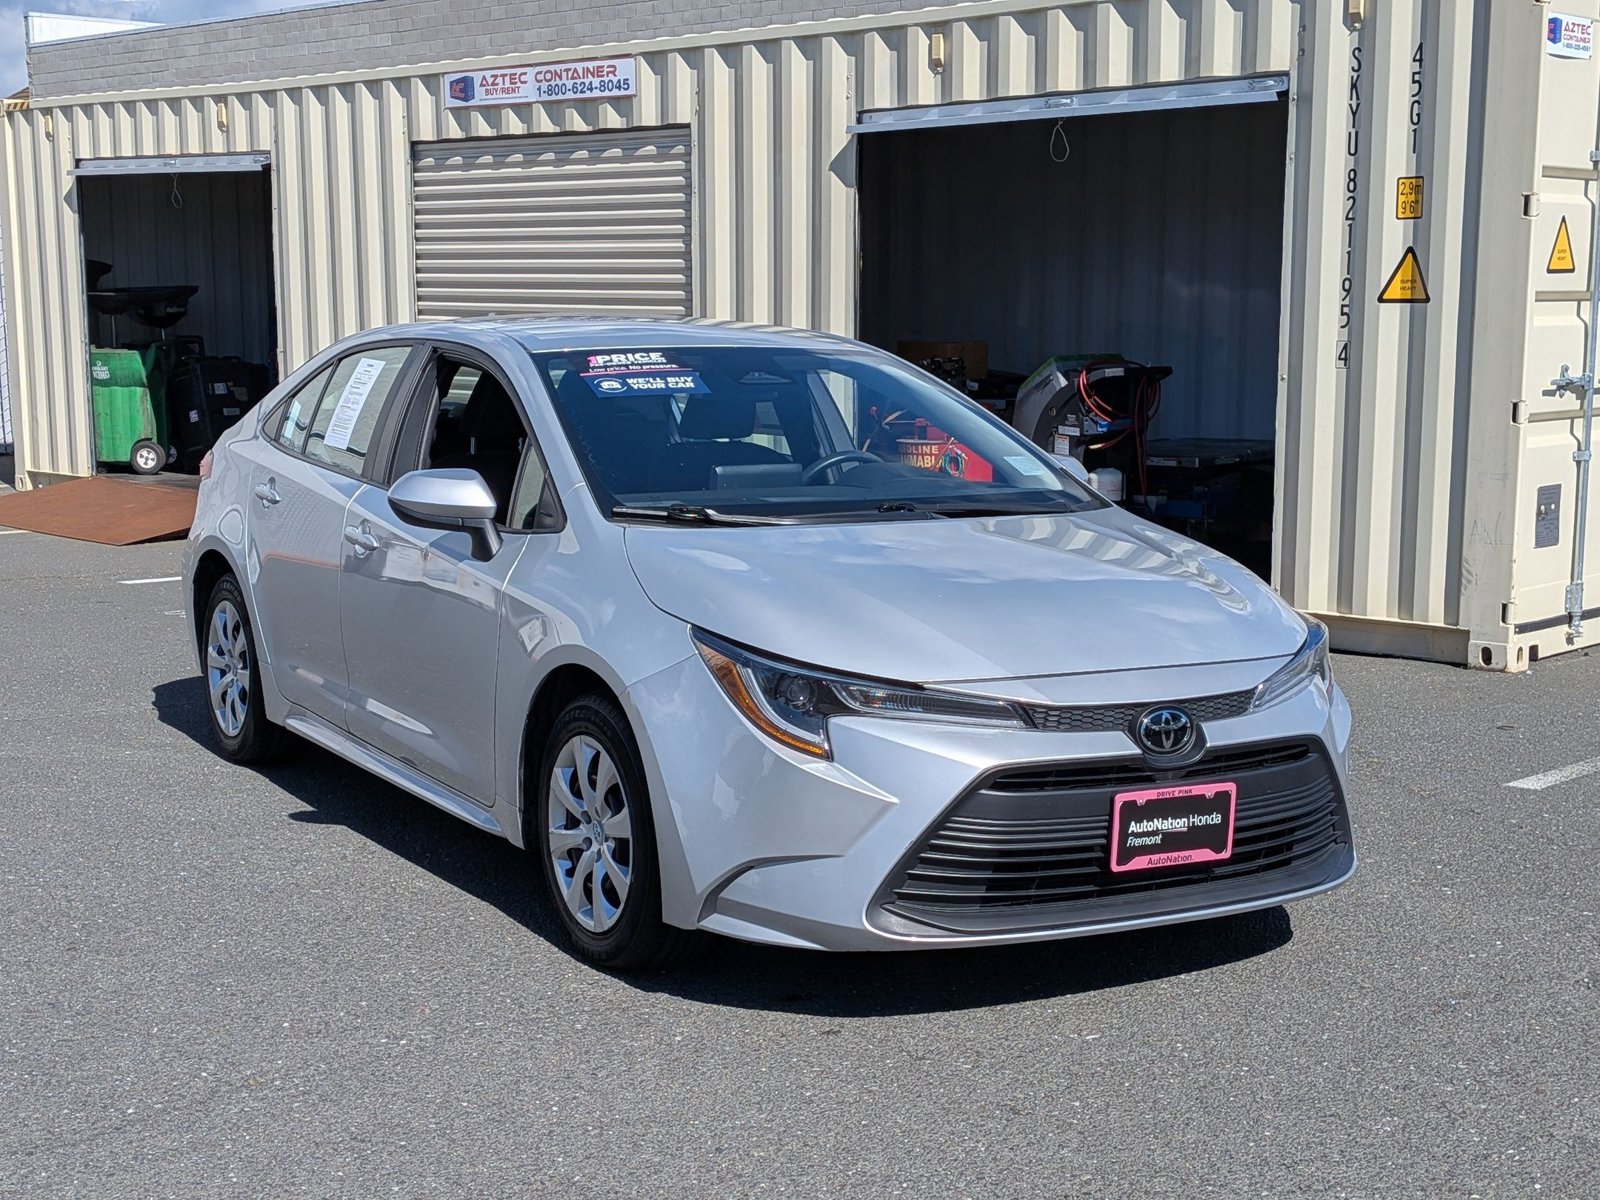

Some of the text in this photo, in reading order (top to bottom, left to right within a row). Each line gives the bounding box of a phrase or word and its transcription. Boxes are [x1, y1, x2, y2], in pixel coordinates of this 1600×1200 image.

[1563, 21, 1591, 36] AZTEC
[1563, 33, 1591, 44] CONTAINER
[479, 64, 618, 87] AZTEC CONTAINER
[484, 86, 521, 96] BUY/RENT
[536, 77, 630, 98] 1-800-624-8045
[1410, 42, 1424, 154] 45G1
[1338, 47, 1362, 367] SKYU 821195 4
[1128, 812, 1222, 834] AutoNation Honda
[1126, 834, 1163, 847] Fremont
